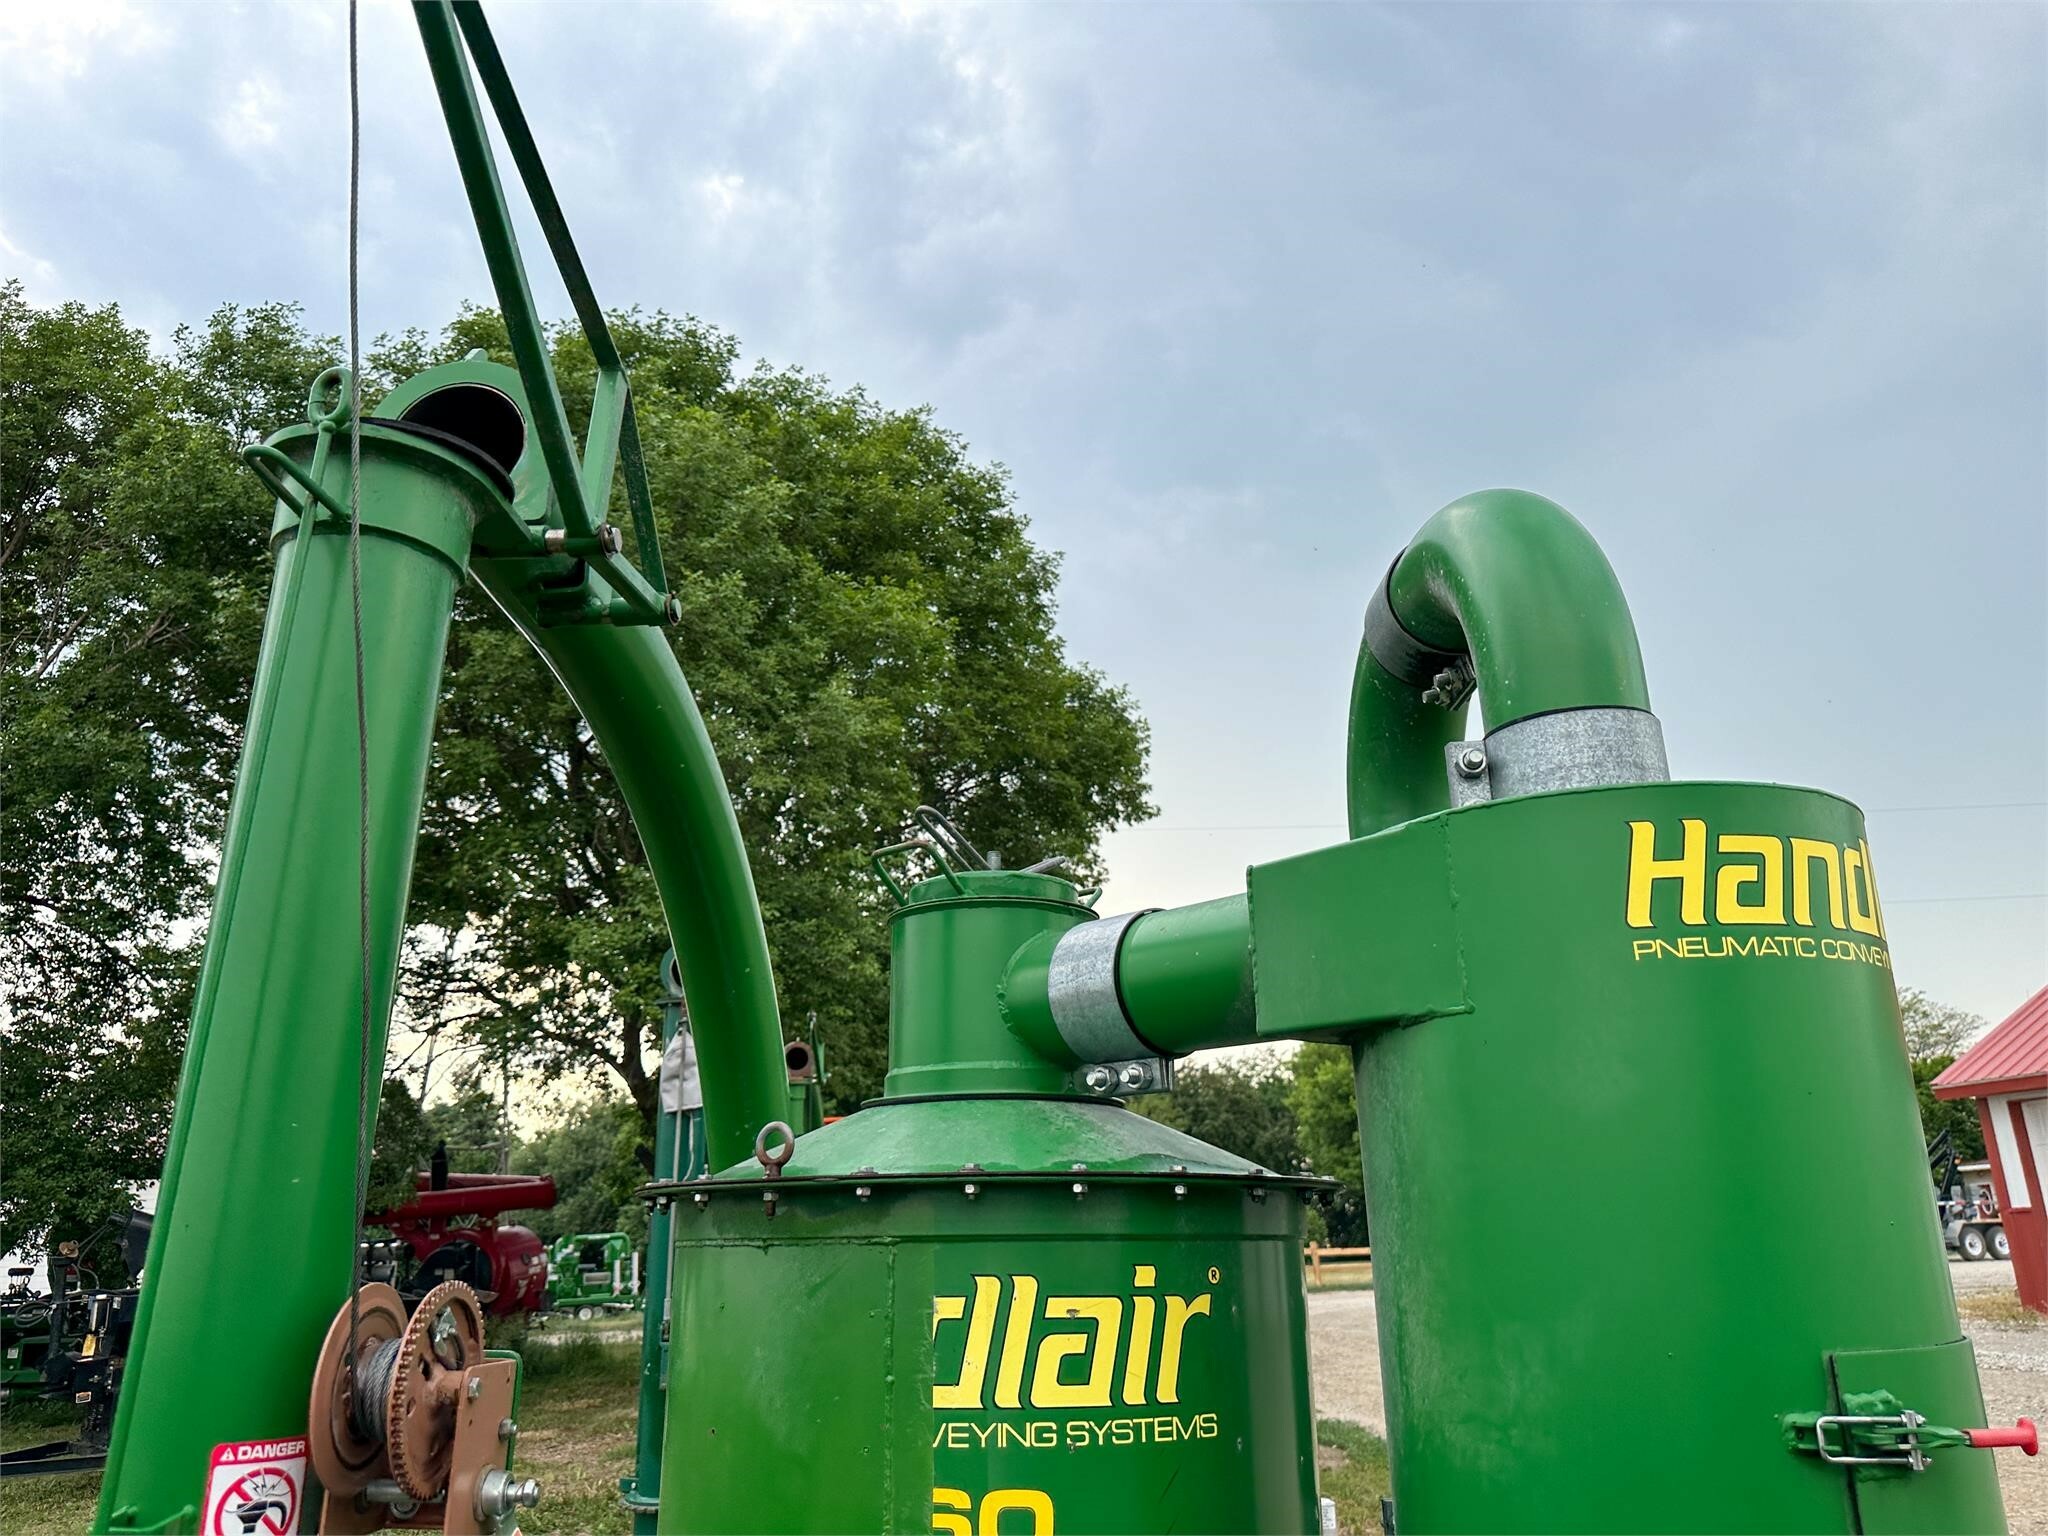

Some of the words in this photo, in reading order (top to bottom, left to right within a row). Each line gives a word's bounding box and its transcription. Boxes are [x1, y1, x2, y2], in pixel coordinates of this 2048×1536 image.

[1632, 935, 1817, 961] PNEUMATIC
[1066, 1413, 1218, 1448] SYSTEMS
[236, 1441, 305, 1460] DANGER
